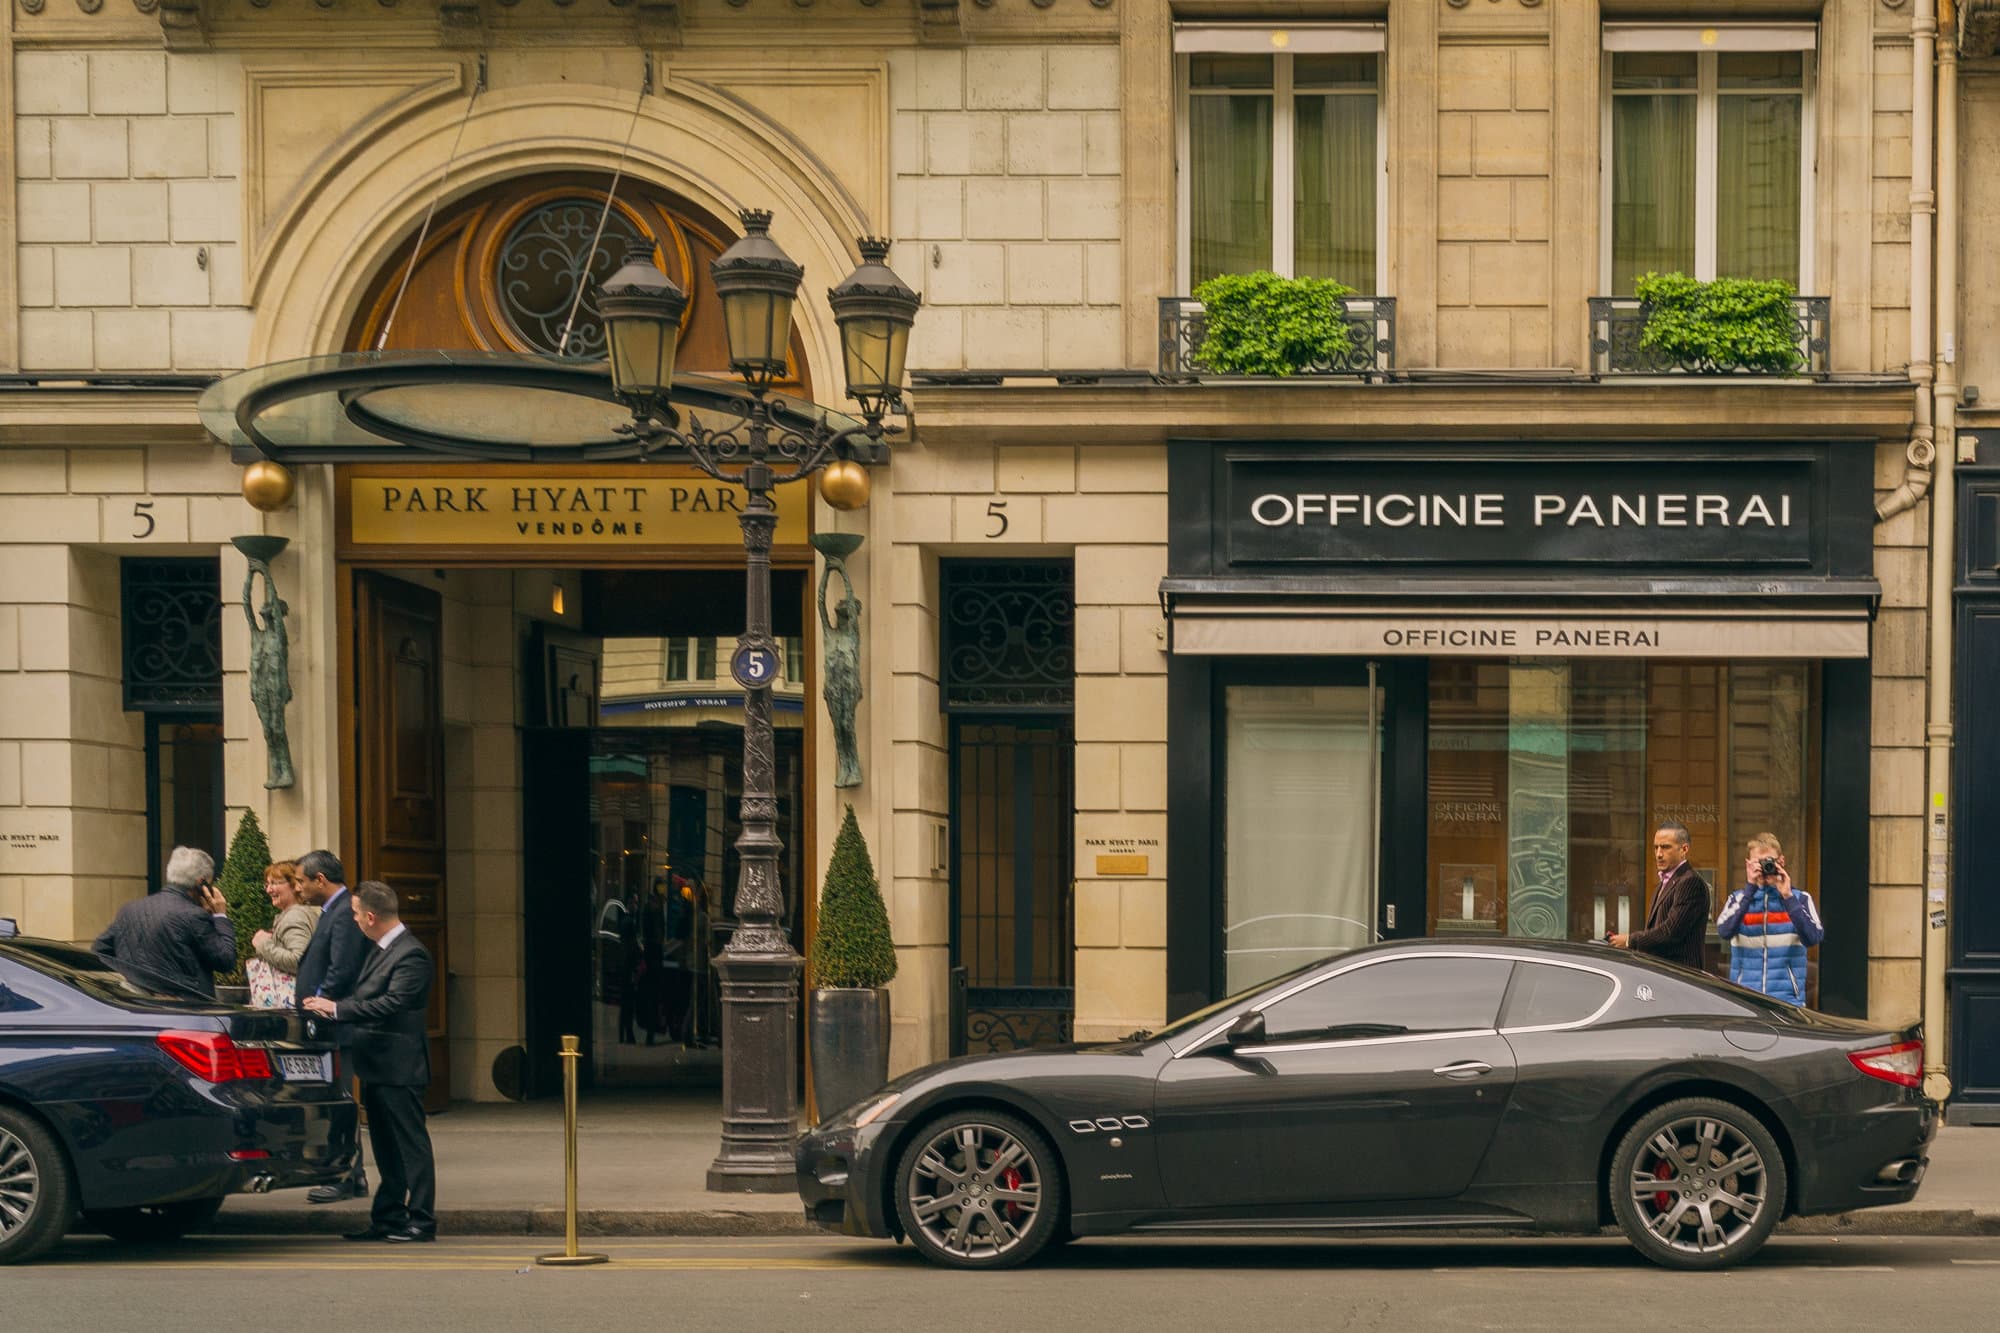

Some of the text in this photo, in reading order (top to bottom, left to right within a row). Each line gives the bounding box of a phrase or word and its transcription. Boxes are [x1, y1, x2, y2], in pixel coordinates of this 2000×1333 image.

[382, 487, 489, 513] PARK
[511, 487, 648, 513] HYATT
[1251, 493, 1791, 526] OFFICINE PANERAI
[132, 502, 155, 539] 5
[516, 517, 643, 536] VENDÔME
[985, 501, 1008, 539] 5
[1382, 629, 1660, 647] OFFICINE PANERAI
[748, 651, 765, 678] 5
[1434, 812, 1502, 822] PANERAI
[1435, 802, 1501, 812] OFFICINE
